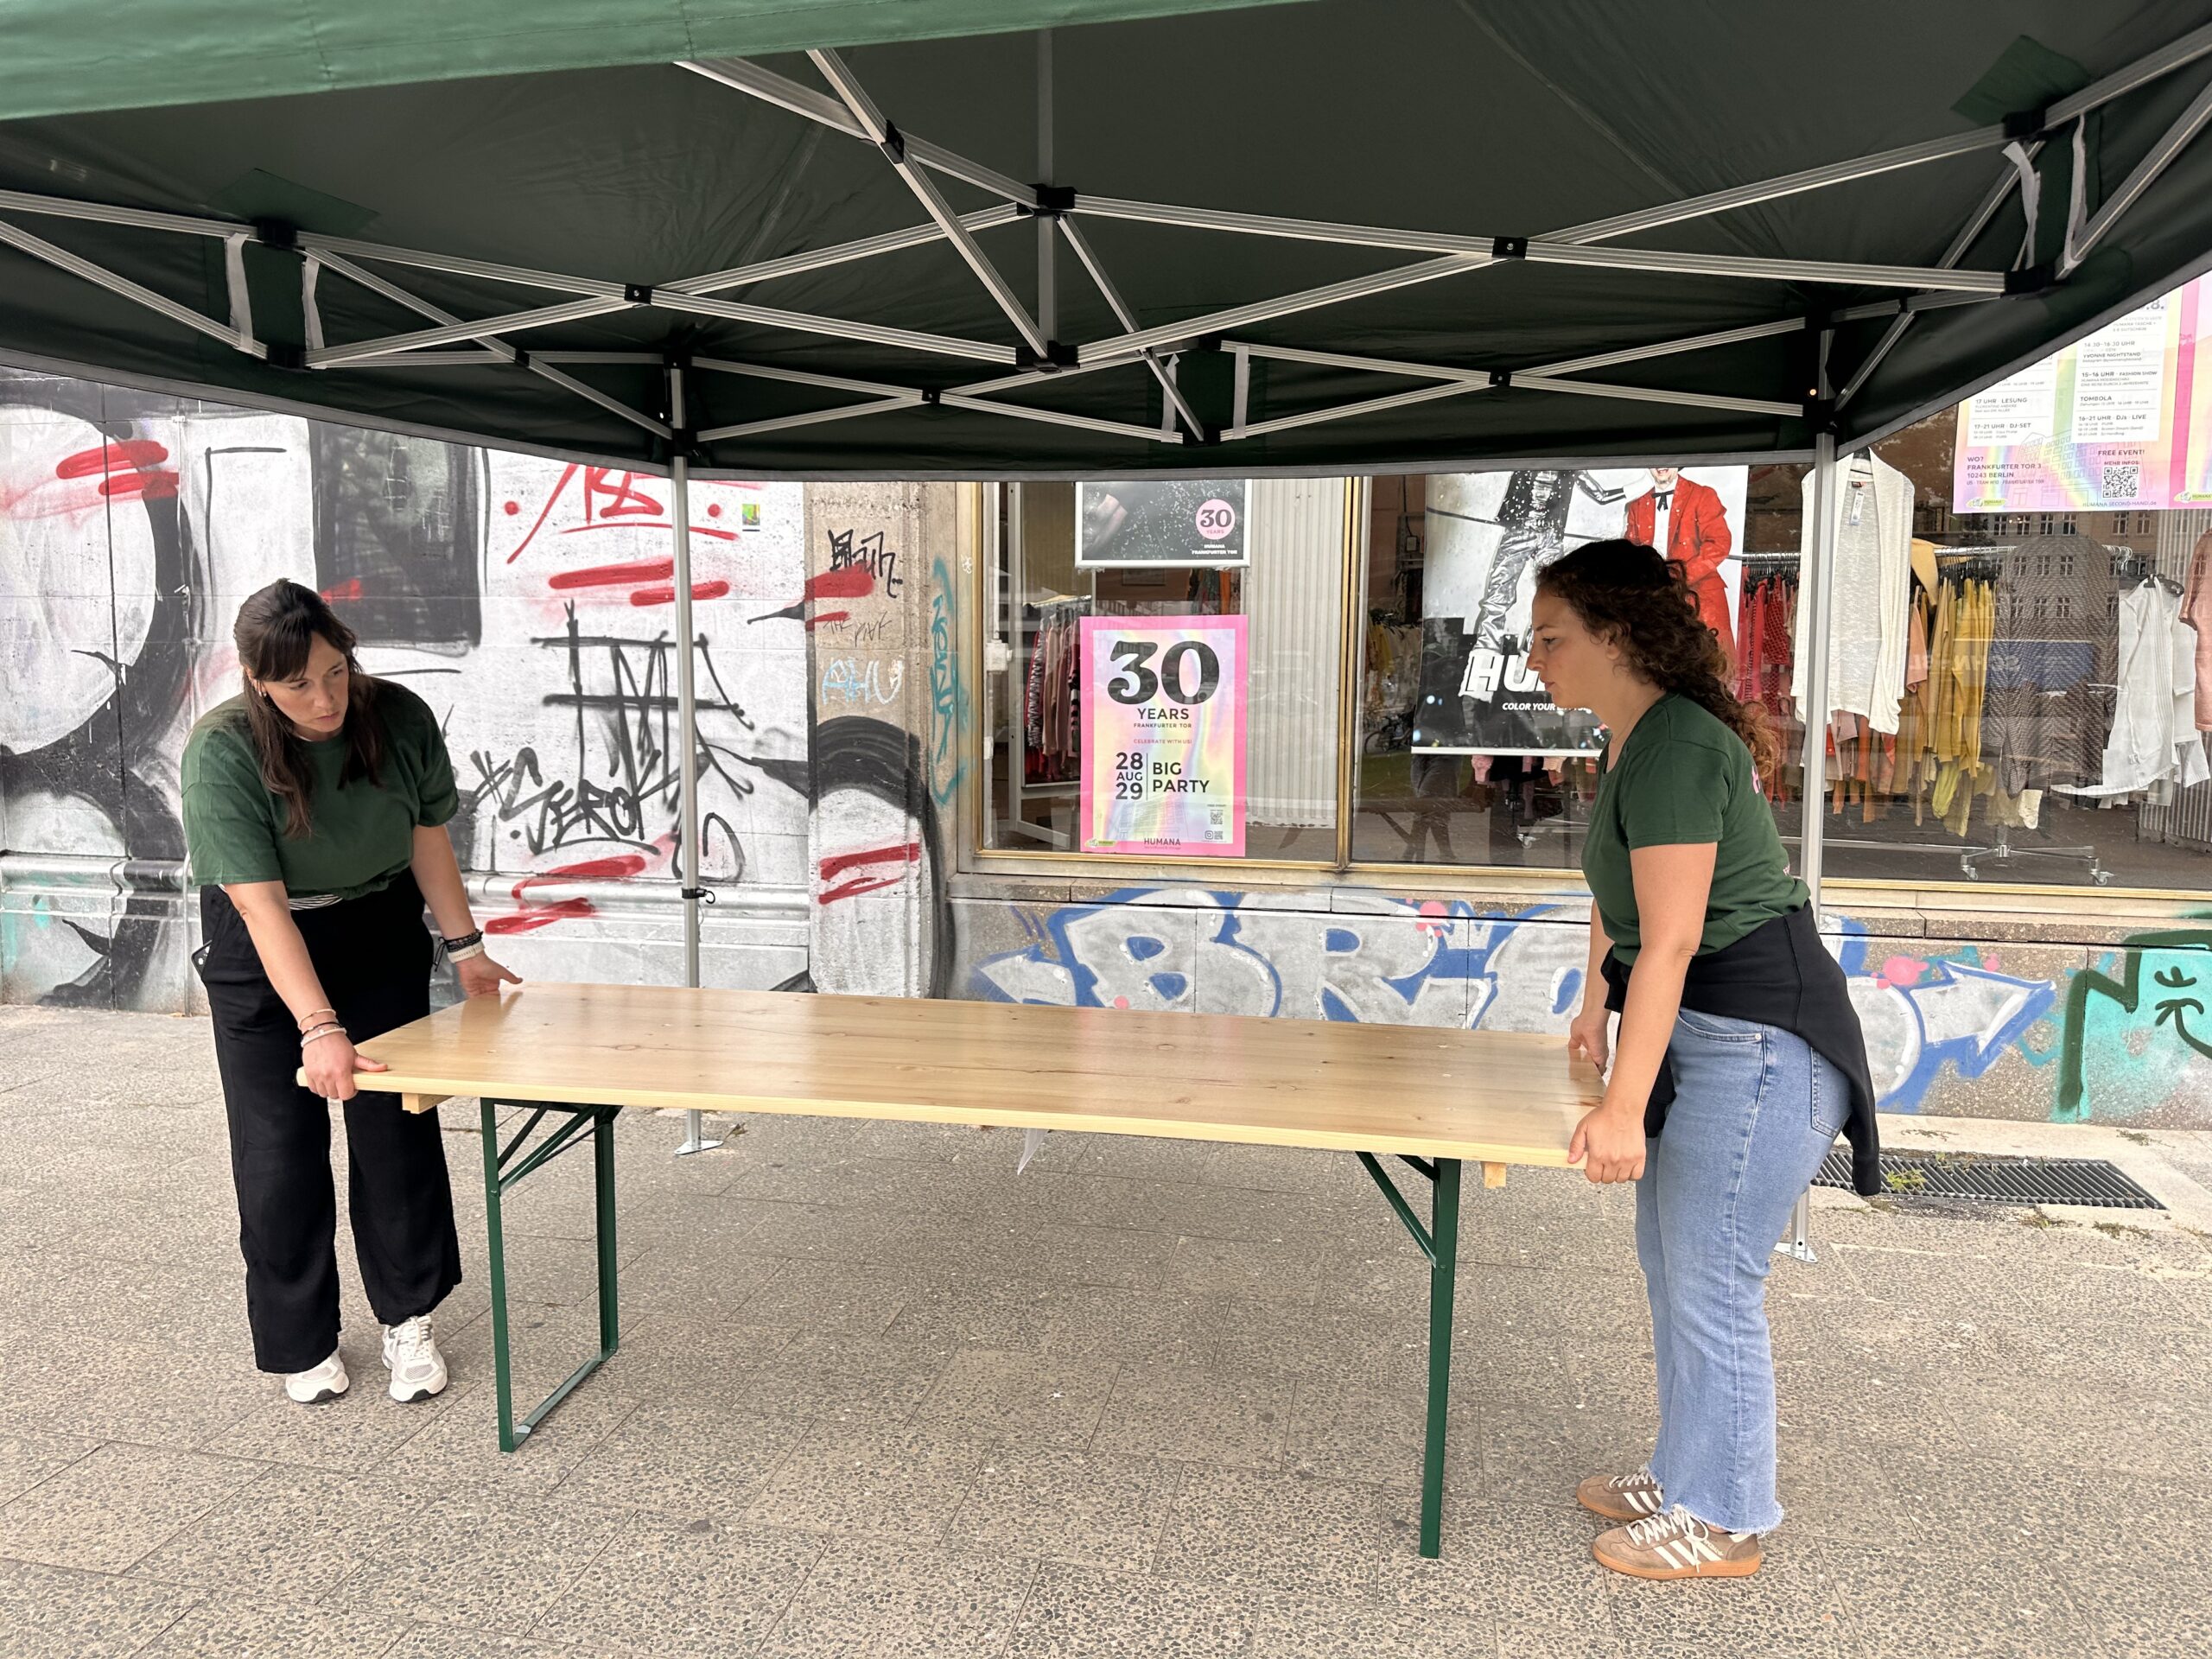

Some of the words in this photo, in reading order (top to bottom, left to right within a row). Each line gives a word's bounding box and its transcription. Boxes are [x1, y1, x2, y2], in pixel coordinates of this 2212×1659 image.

[1199, 509, 1232, 528] 30
[1107, 640, 1220, 705] 30
[1465, 654, 1546, 692] HU
[1502, 702, 1531, 711] COLOR
[1533, 702, 1556, 711] YOUR
[1137, 708, 1190, 720] YEARS
[1116, 752, 1143, 771] 28
[1153, 762, 1182, 775] BIG
[1116, 772, 1143, 781] AUG
[1116, 782, 1143, 800] 29
[1153, 779, 1210, 793] PARTY
[1143, 837, 1181, 846] HUMANA
